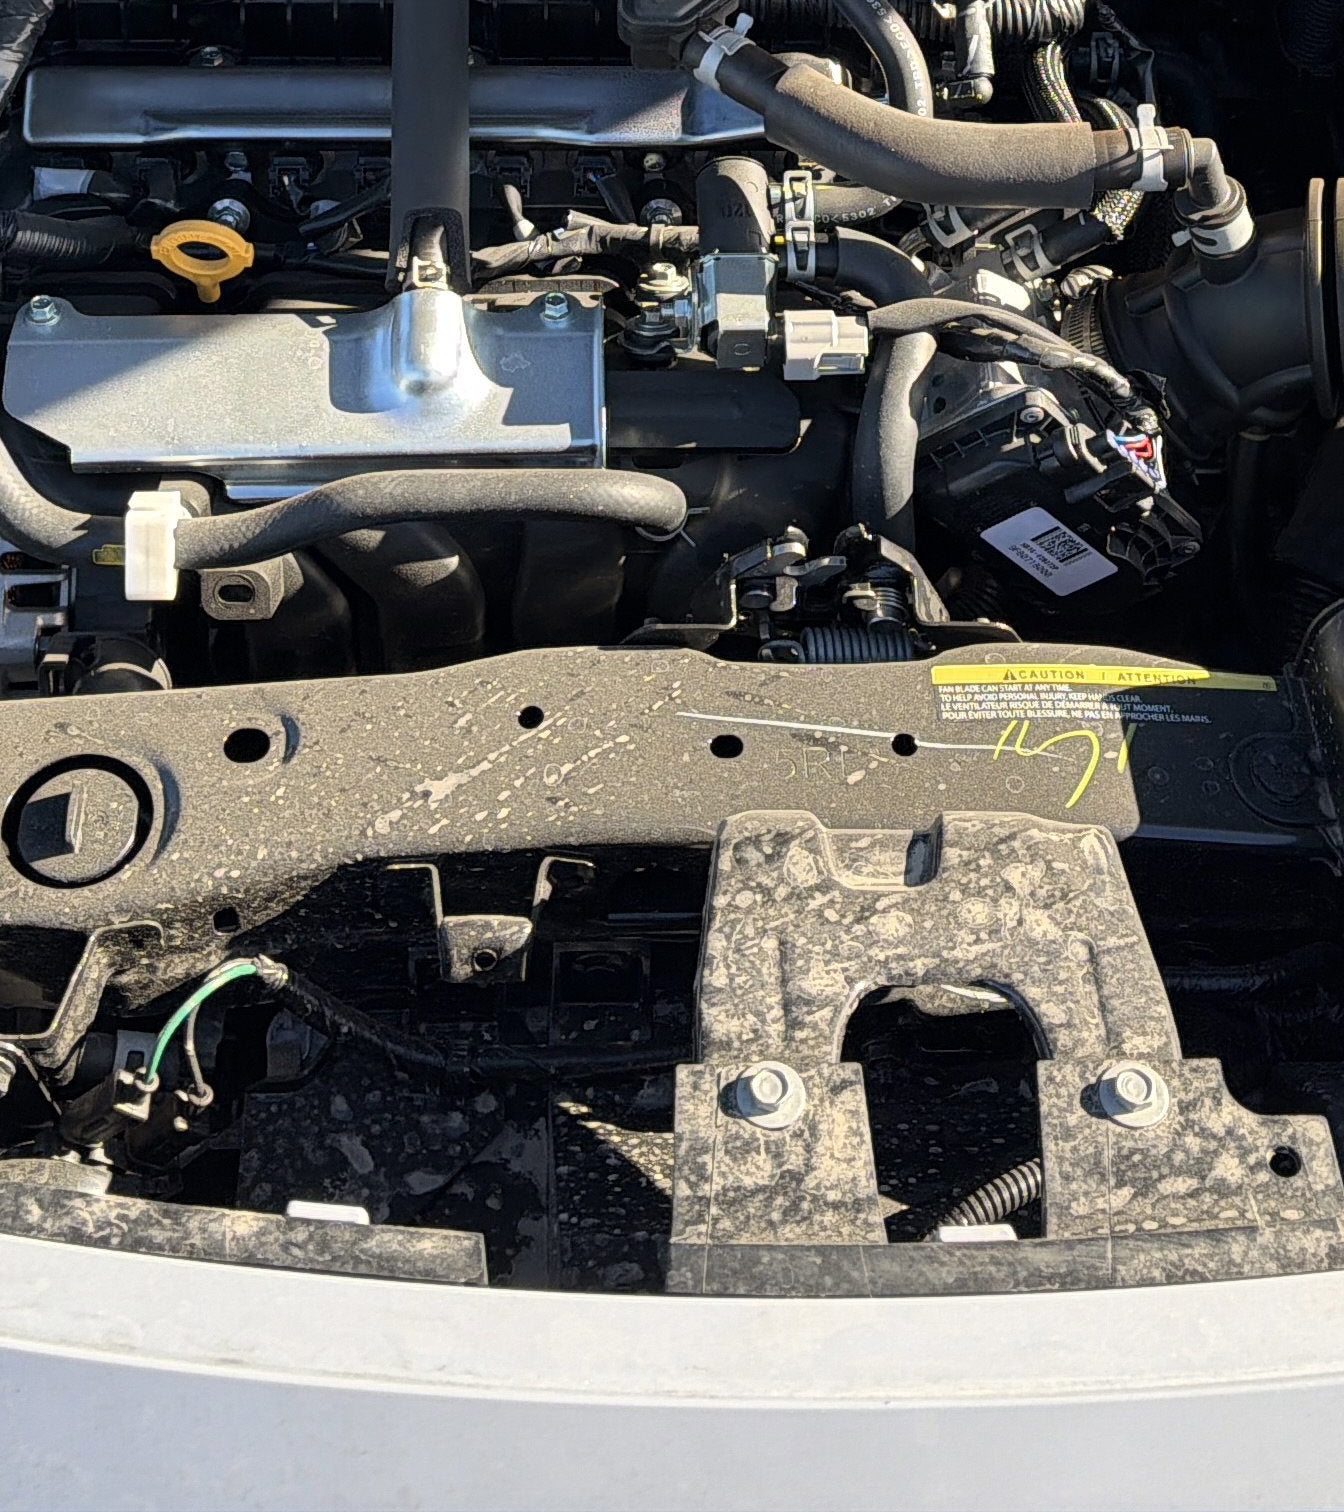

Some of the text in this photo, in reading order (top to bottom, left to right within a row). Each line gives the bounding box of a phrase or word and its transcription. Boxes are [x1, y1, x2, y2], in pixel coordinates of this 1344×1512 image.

[1018, 669, 1196, 686] CAUTION ATTENTION
[938, 684, 955, 694] FAN
[955, 683, 981, 693] BLADE
[981, 683, 999, 693] CAN
[999, 683, 1023, 692] START
[1023, 683, 1034, 692] AT
[1034, 683, 1053, 692] ANY
[940, 693, 952, 702] TO
[952, 693, 972, 702] HELP
[973, 692, 998, 702] AVOID
[998, 692, 1038, 701] PERSONAL
[1068, 692, 1088, 701] KEEP
[1088, 692, 1116, 702] HANDS
[940, 702, 952, 711] LE
[951, 701, 1009, 711] VENTILATEUR
[1008, 700, 1041, 710] RISQUE
[1041, 700, 1054, 709] DE
[1110, 702, 1131, 712] TOUT
[942, 710, 968, 720] POUR
[998, 709, 1026, 719] TOUTE
[1071, 710, 1085, 719] NE
[1085, 710, 1102, 720] PAS
[1102, 710, 1114, 720] EN
[1115, 710, 1166, 722] APPROCHER
